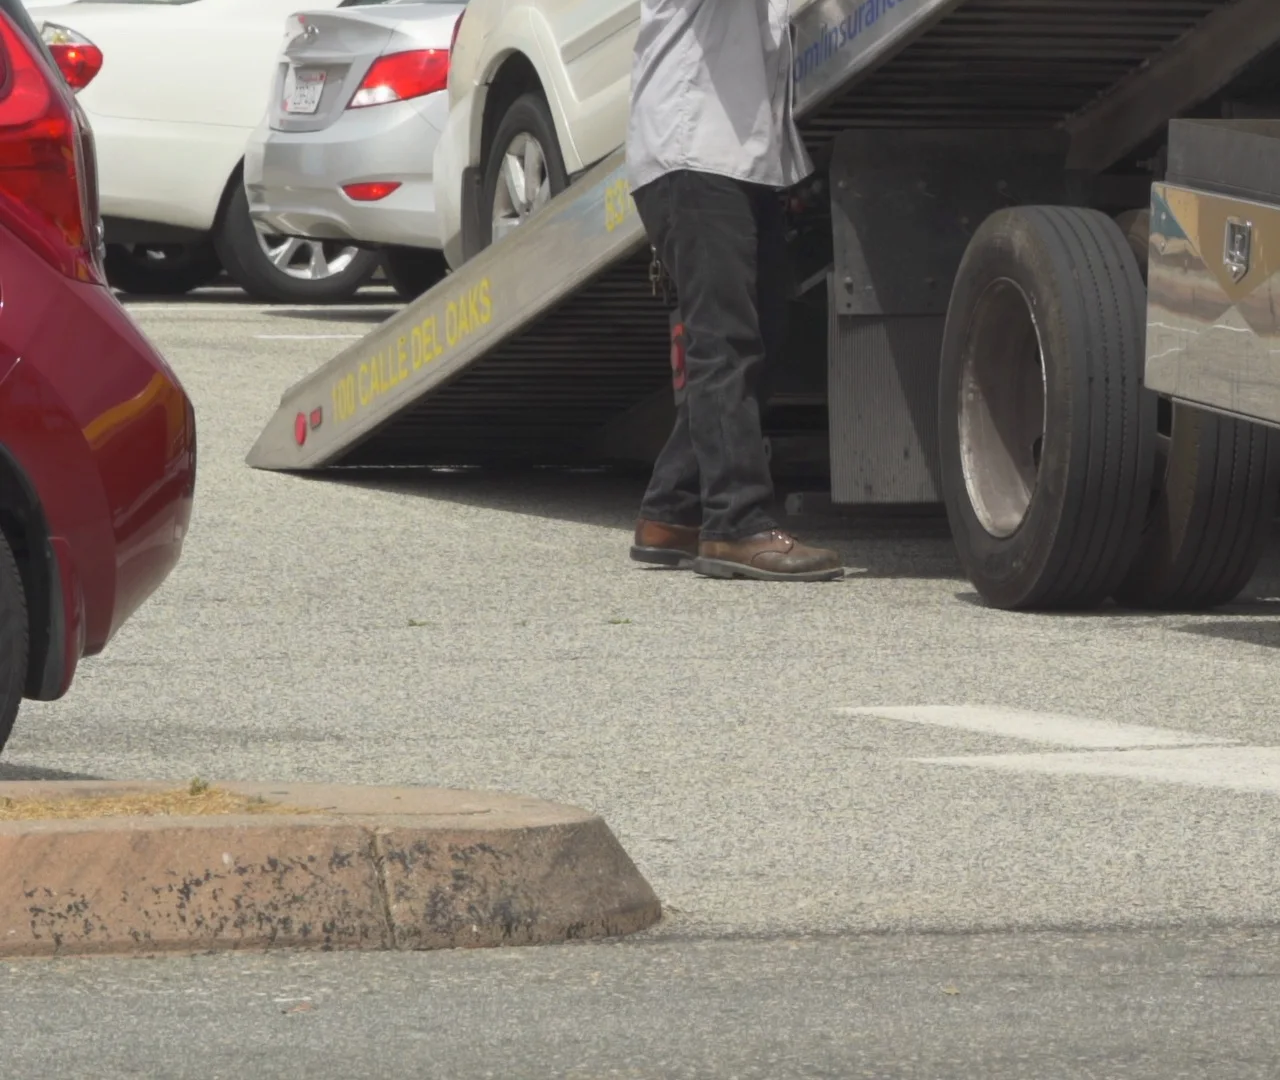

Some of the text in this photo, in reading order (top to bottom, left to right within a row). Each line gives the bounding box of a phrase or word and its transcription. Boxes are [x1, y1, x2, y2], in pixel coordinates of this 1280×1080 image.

[332, 277, 492, 425] 100 CALLE DEL OAKS
